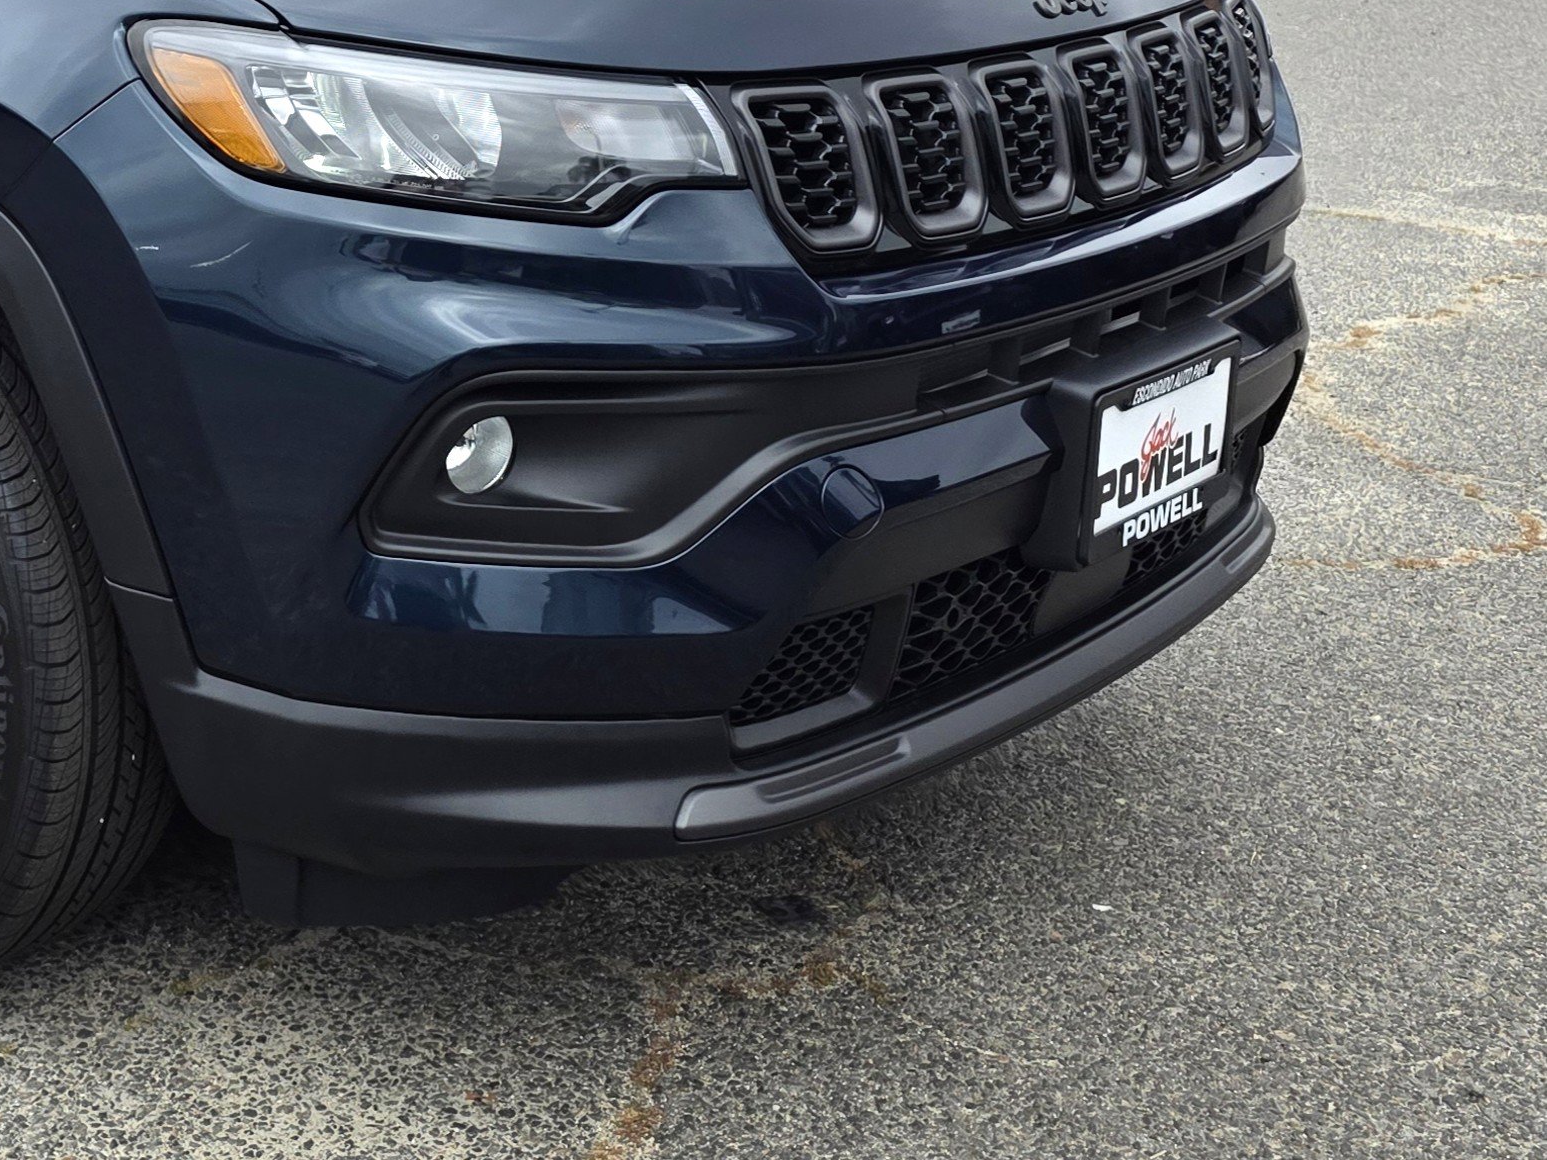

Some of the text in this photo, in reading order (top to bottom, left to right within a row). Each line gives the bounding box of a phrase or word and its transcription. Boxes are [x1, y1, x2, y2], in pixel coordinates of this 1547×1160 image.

[1132, 358, 1212, 405] ESCONDIDO AUTO PARK
[1096, 423, 1218, 520] POWELL
[1122, 488, 1203, 547] POWELL
